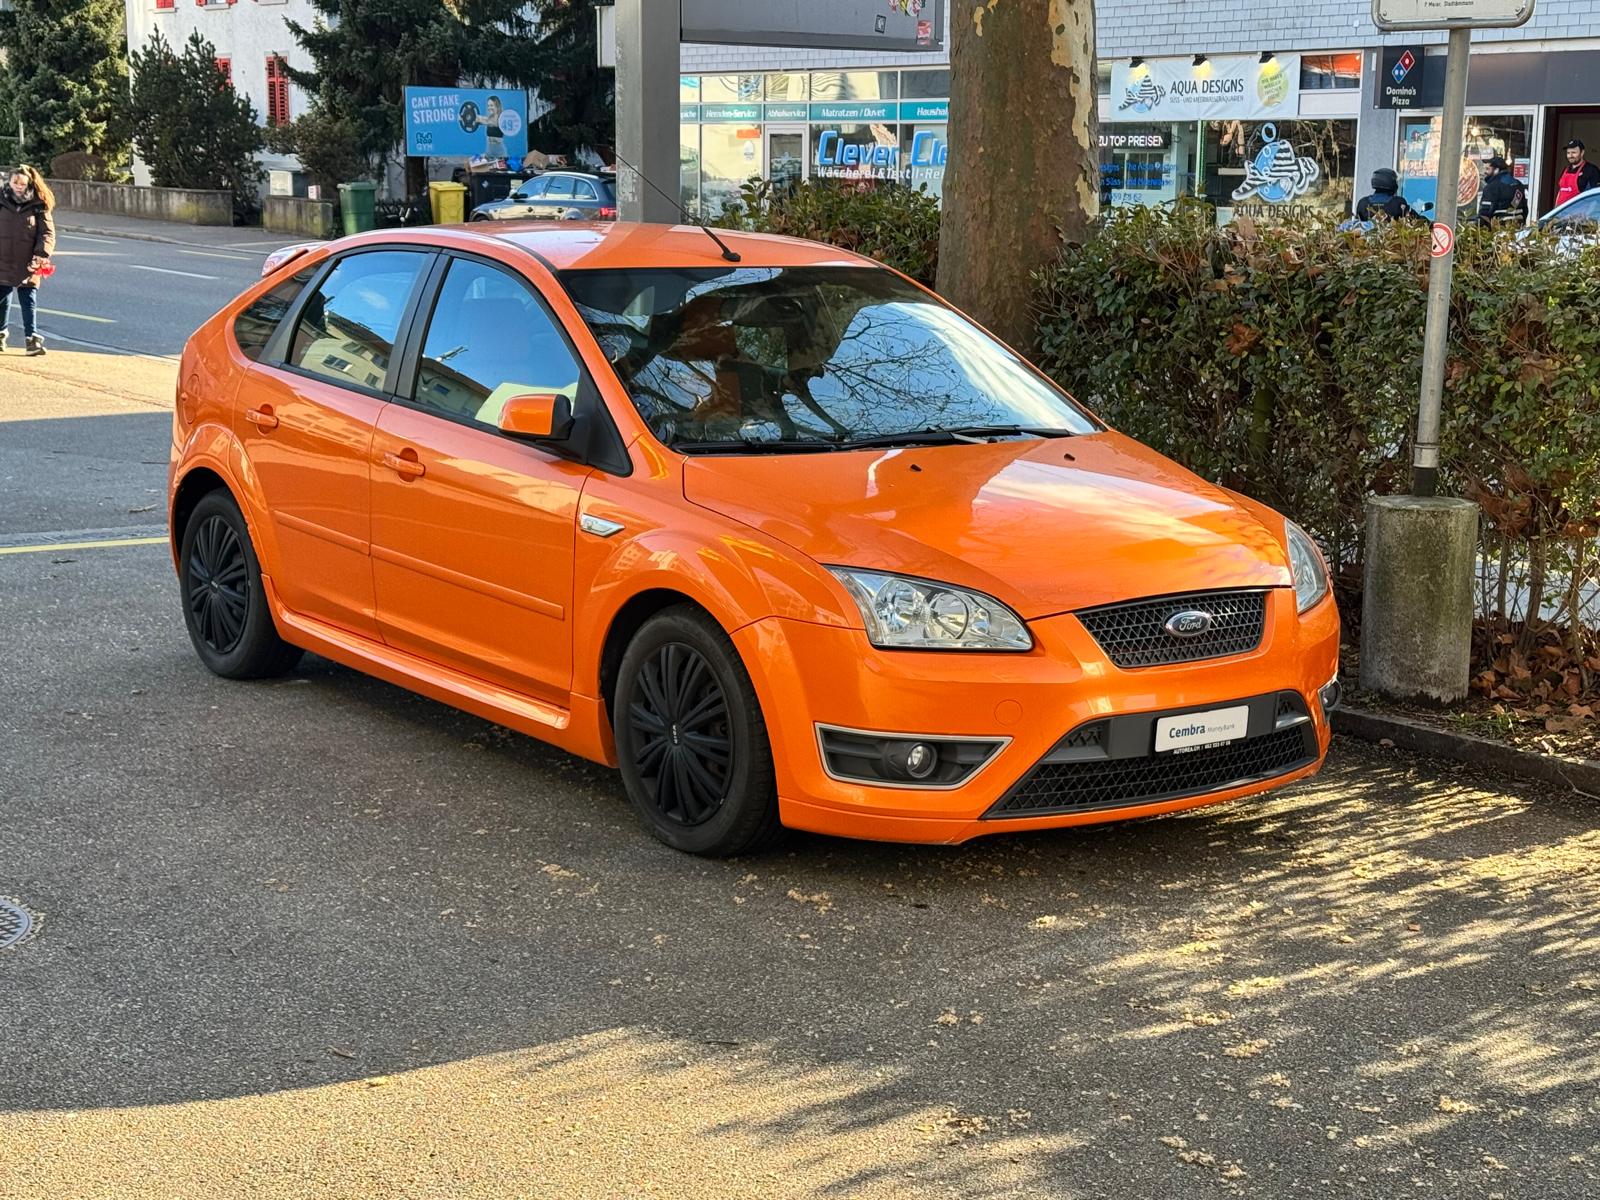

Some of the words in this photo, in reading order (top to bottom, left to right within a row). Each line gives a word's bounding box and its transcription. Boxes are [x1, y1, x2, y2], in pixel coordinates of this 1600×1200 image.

[1170, 80, 1198, 96] AQUA
[1201, 79, 1244, 93] DESIGNS
[1386, 86, 1417, 96] Domino's
[411, 96, 436, 109] CAN'T
[438, 94, 460, 107] FAKE
[1391, 96, 1410, 105] Pizza
[413, 107, 455, 124] STRONG
[705, 107, 758, 118] Hemden-Service
[767, 107, 807, 118] Abholservice
[822, 107, 859, 117] Matratzen
[864, 107, 886, 117] Duvet
[416, 143, 433, 151] GYM
[818, 130, 900, 166] Clever
[1109, 135, 1126, 147] TOP
[1127, 135, 1164, 147] PREISEN
[1179, 616, 1202, 631] Ford
[1169, 724, 1206, 738] Cembra
